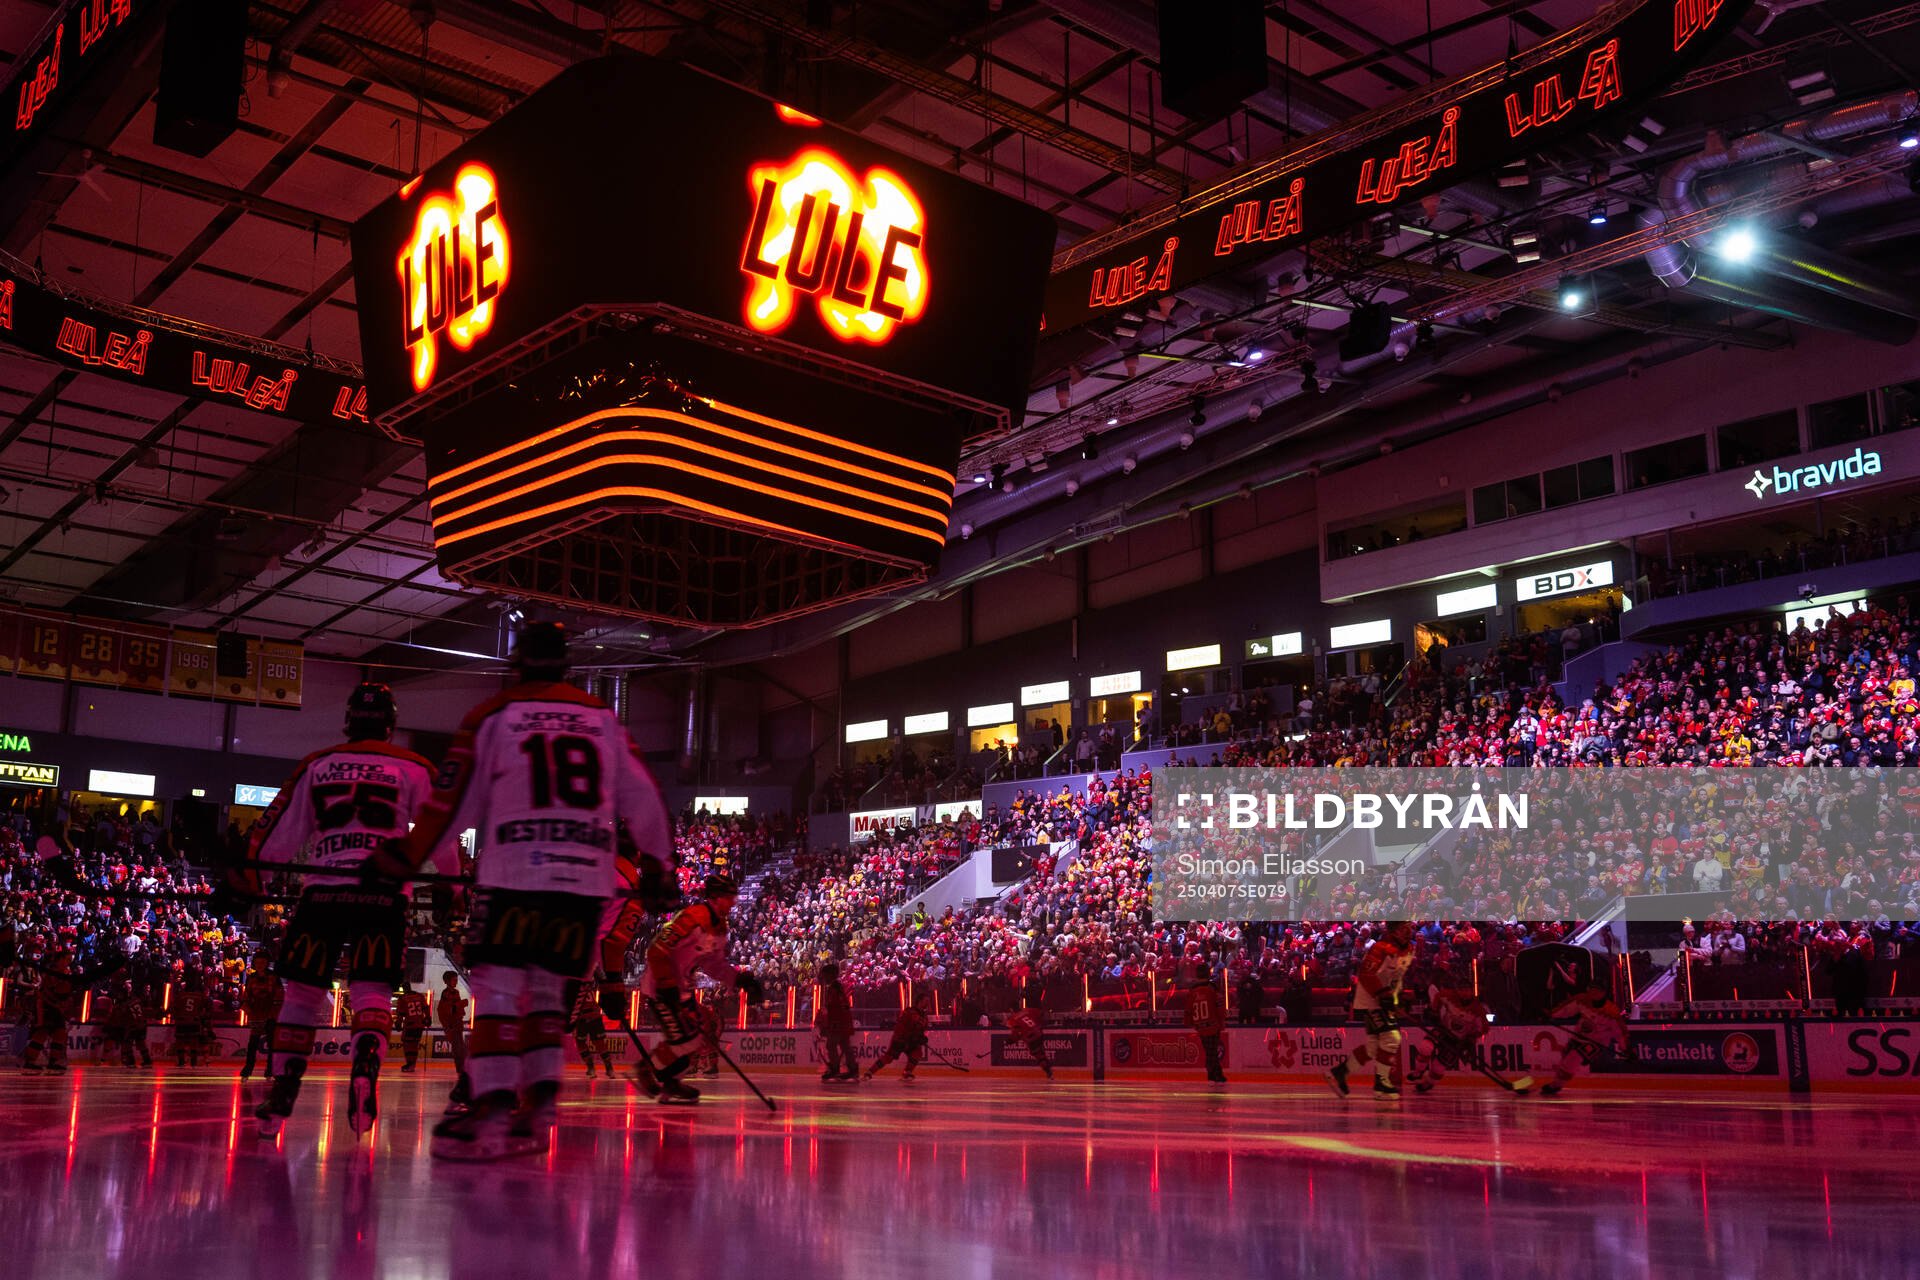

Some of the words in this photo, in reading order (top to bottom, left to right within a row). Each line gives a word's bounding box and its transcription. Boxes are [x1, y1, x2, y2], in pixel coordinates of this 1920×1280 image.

[1505, 38, 1623, 137] LULEÅ
[1214, 177, 1305, 257] LULEÅ
[741, 178, 921, 323] LULE
[403, 200, 499, 349] LULE
[56, 317, 153, 376] LULEÅ
[192, 351, 299, 412] LULEÅ
[1773, 447, 1882, 494] bravida
[1535, 567, 1594, 595] BDX
[80, 633, 113, 662] 28
[177, 650, 209, 670] 1996
[266, 662, 298, 681] 2015
[315, 771, 397, 785] WELLNESS
[328, 761, 385, 775] NORDIC
[521, 734, 602, 809] 18
[740, 1037, 771, 1050] COOP
[774, 1036, 796, 1050] FÖR
[1301, 1032, 1343, 1049] Luleå
[1655, 1042, 1716, 1061] enkelt
[739, 1052, 796, 1065] NORRBOTTEN
